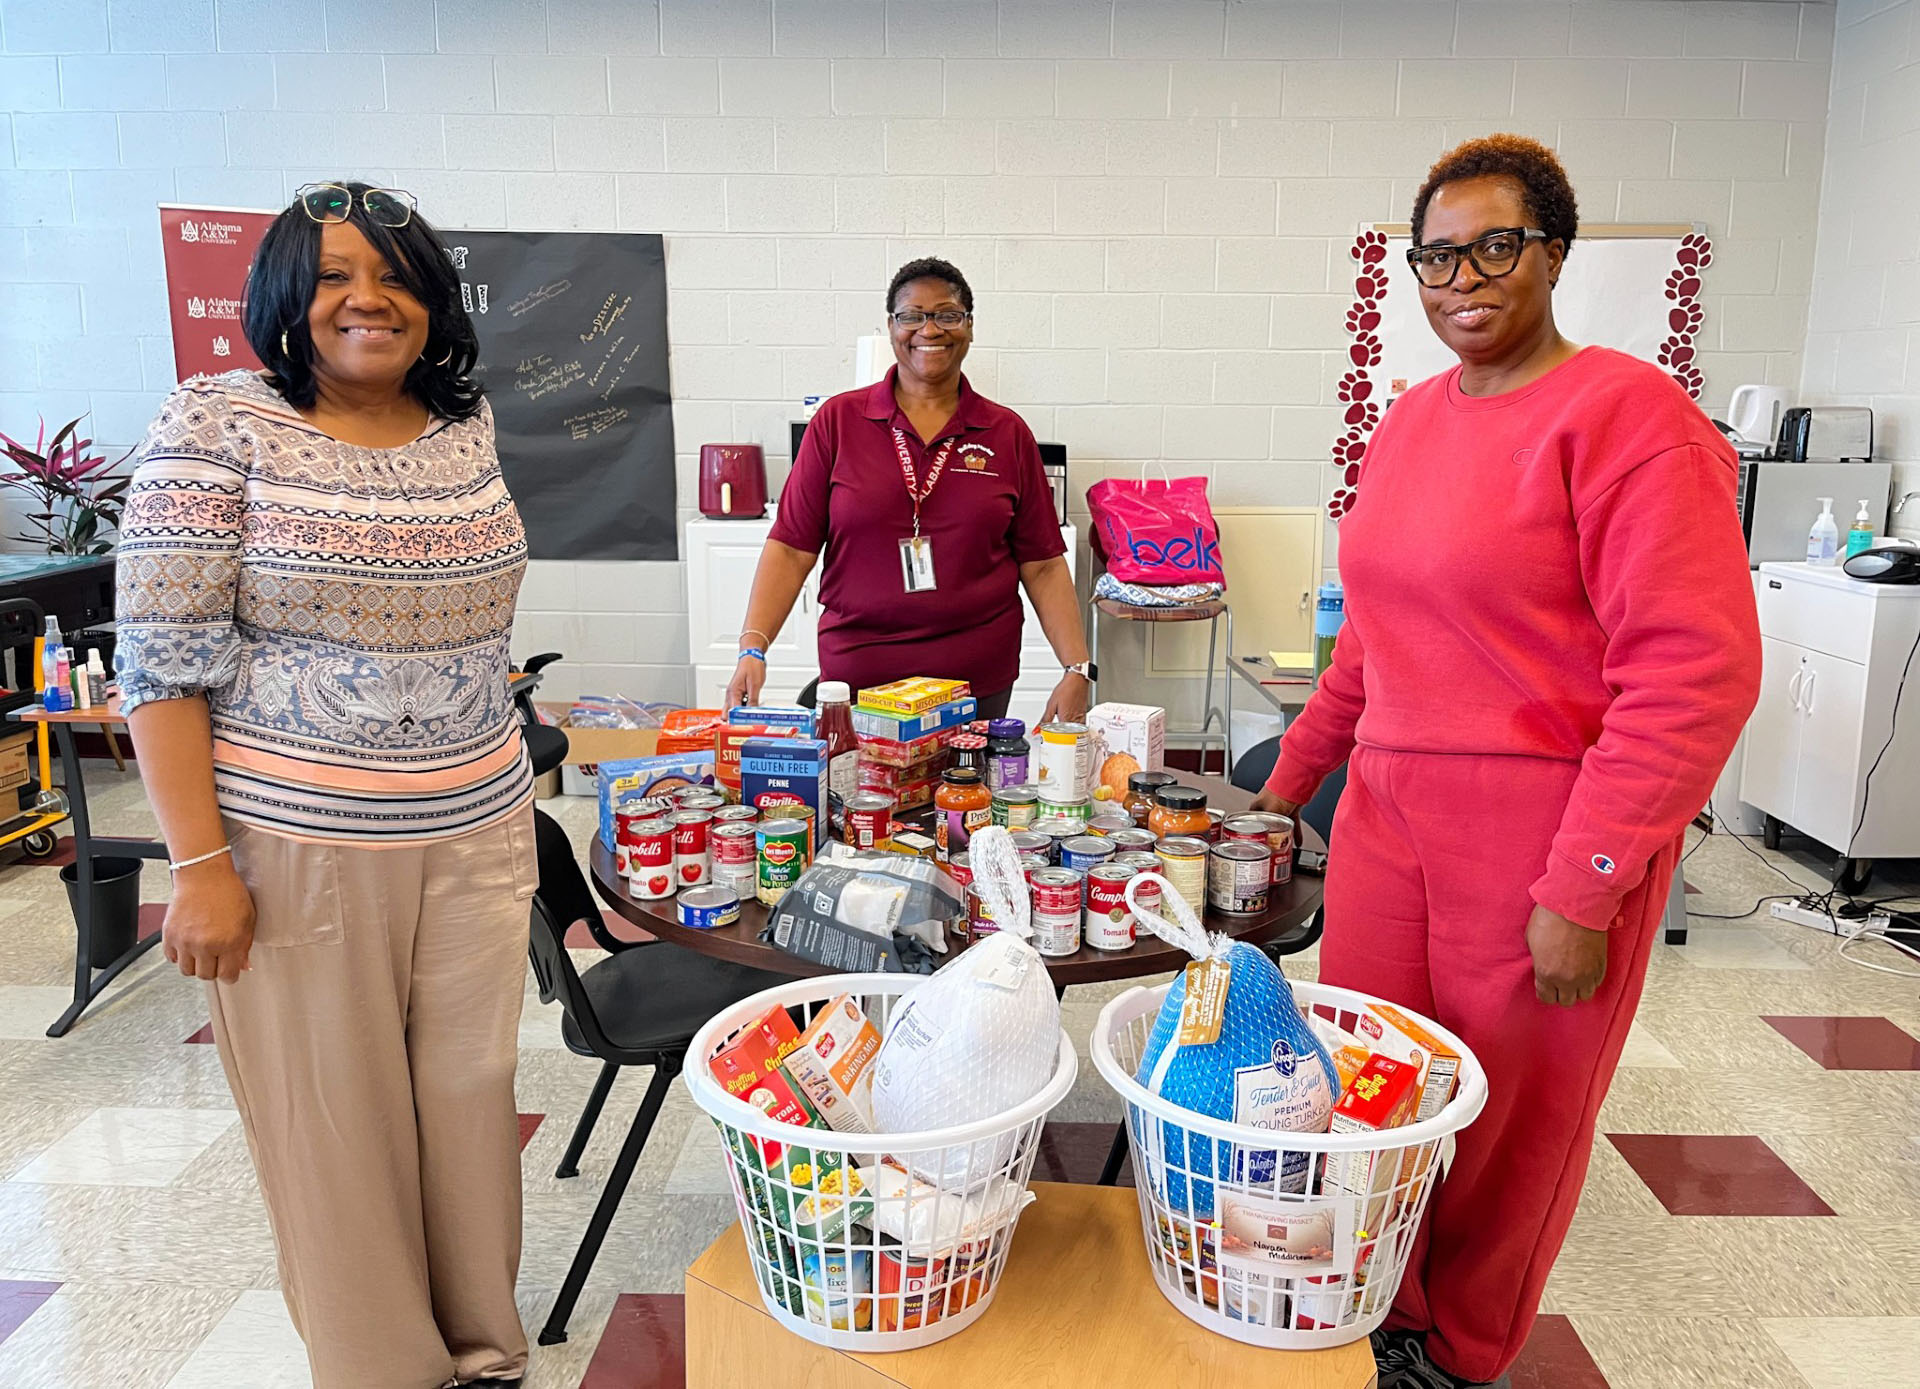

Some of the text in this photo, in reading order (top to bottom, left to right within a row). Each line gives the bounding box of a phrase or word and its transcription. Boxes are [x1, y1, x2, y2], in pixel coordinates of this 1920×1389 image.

[200, 222, 242, 232] Alabama
[201, 230, 229, 239] A&M
[208, 306, 235, 315] A&M
[919, 450, 949, 503] ALABAMA
[1127, 527, 1222, 572] belk
[860, 692, 949, 711] MISO-CUP MISO-CUP
[722, 750, 741, 761] STU
[750, 761, 785, 773] GLUTEN
[788, 763, 809, 774] FREE
[768, 779, 790, 788] PENNE
[760, 796, 801, 807] Barilla
[1103, 928, 1128, 936] Tomato
[841, 1035, 878, 1085] BAKING MIX
[727, 1071, 757, 1092] Stuffing
[1357, 1074, 1388, 1101] Stuffing
[1250, 1072, 1322, 1109] Tender & Juicy
[1275, 1100, 1311, 1116] PREMIUM
[1251, 1104, 1326, 1130] YOUNG TURKE
[1333, 1112, 1358, 1127] Nutrition
[1243, 1210, 1288, 1224] THANKSGIVING
